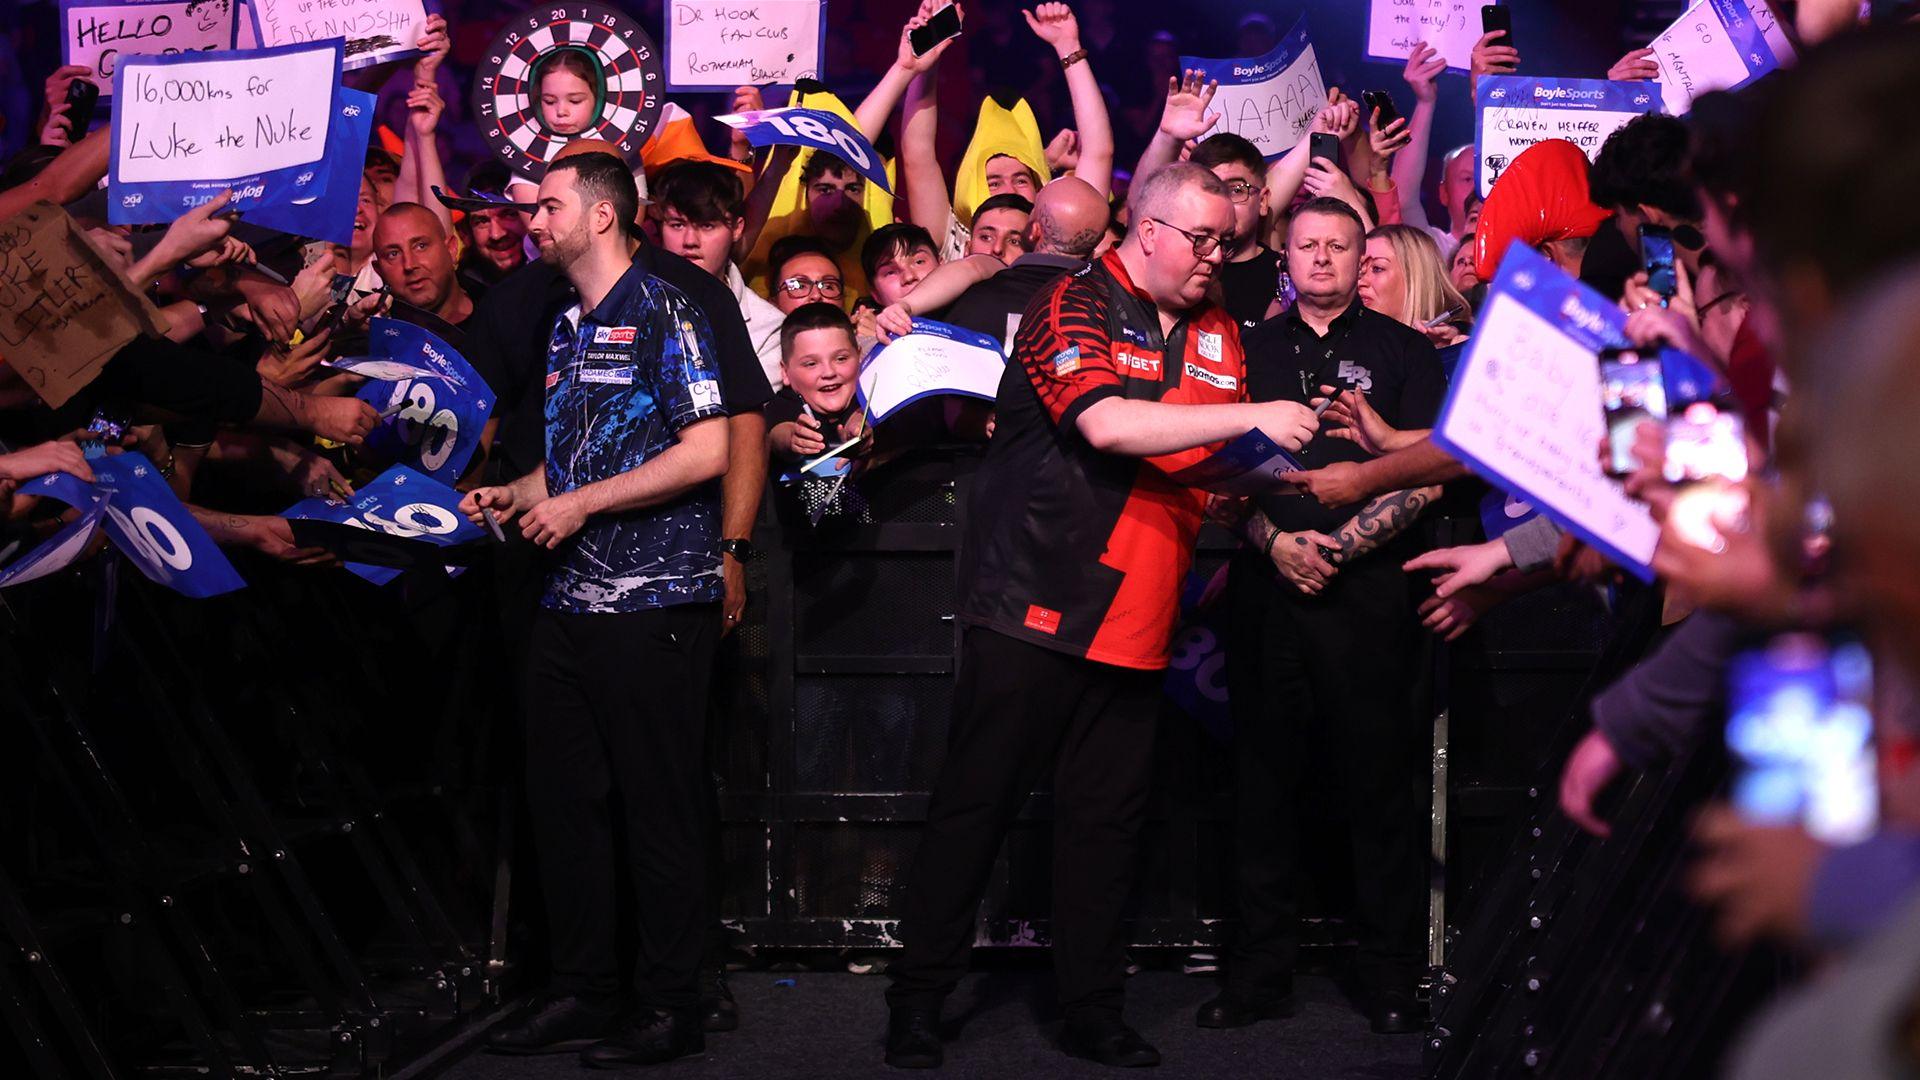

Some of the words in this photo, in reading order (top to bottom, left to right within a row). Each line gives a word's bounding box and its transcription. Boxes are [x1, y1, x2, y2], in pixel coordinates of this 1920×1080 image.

[551, 8, 566, 20] 20
[581, 9, 588, 18] 1
[715, 7, 760, 21] HOOK
[1394, 15, 1410, 24] the
[529, 18, 539, 29] 5
[602, 14, 616, 27] 18
[77, 14, 172, 48] HELLO
[623, 29, 634, 39] 4
[1695, 23, 1712, 44] GO
[505, 32, 520, 46] 12
[636, 45, 650, 60] 13
[492, 56, 502, 65] 9
[1233, 48, 1290, 77] BoyleSports
[646, 73, 656, 81] 6
[246, 76, 273, 97] for
[482, 77, 494, 91] 14
[1534, 86, 1605, 100] BoyleSports
[645, 95, 656, 108] 10
[482, 103, 492, 116] 11
[215, 125, 245, 149] the
[255, 108, 312, 149] Nuke
[634, 118, 648, 134] 15
[1498, 121, 1548, 132] CRAVEN
[1558, 122, 1599, 133] HEIFFER
[489, 129, 500, 137] 8
[620, 141, 631, 152] 2
[760, 116, 871, 170] 180
[502, 145, 516, 159] 16
[523, 160, 533, 171] 7
[597, 328, 609, 340] sky
[609, 329, 635, 340] sports
[422, 342, 468, 385] BoyleSports
[1337, 360, 1373, 391] EPS
